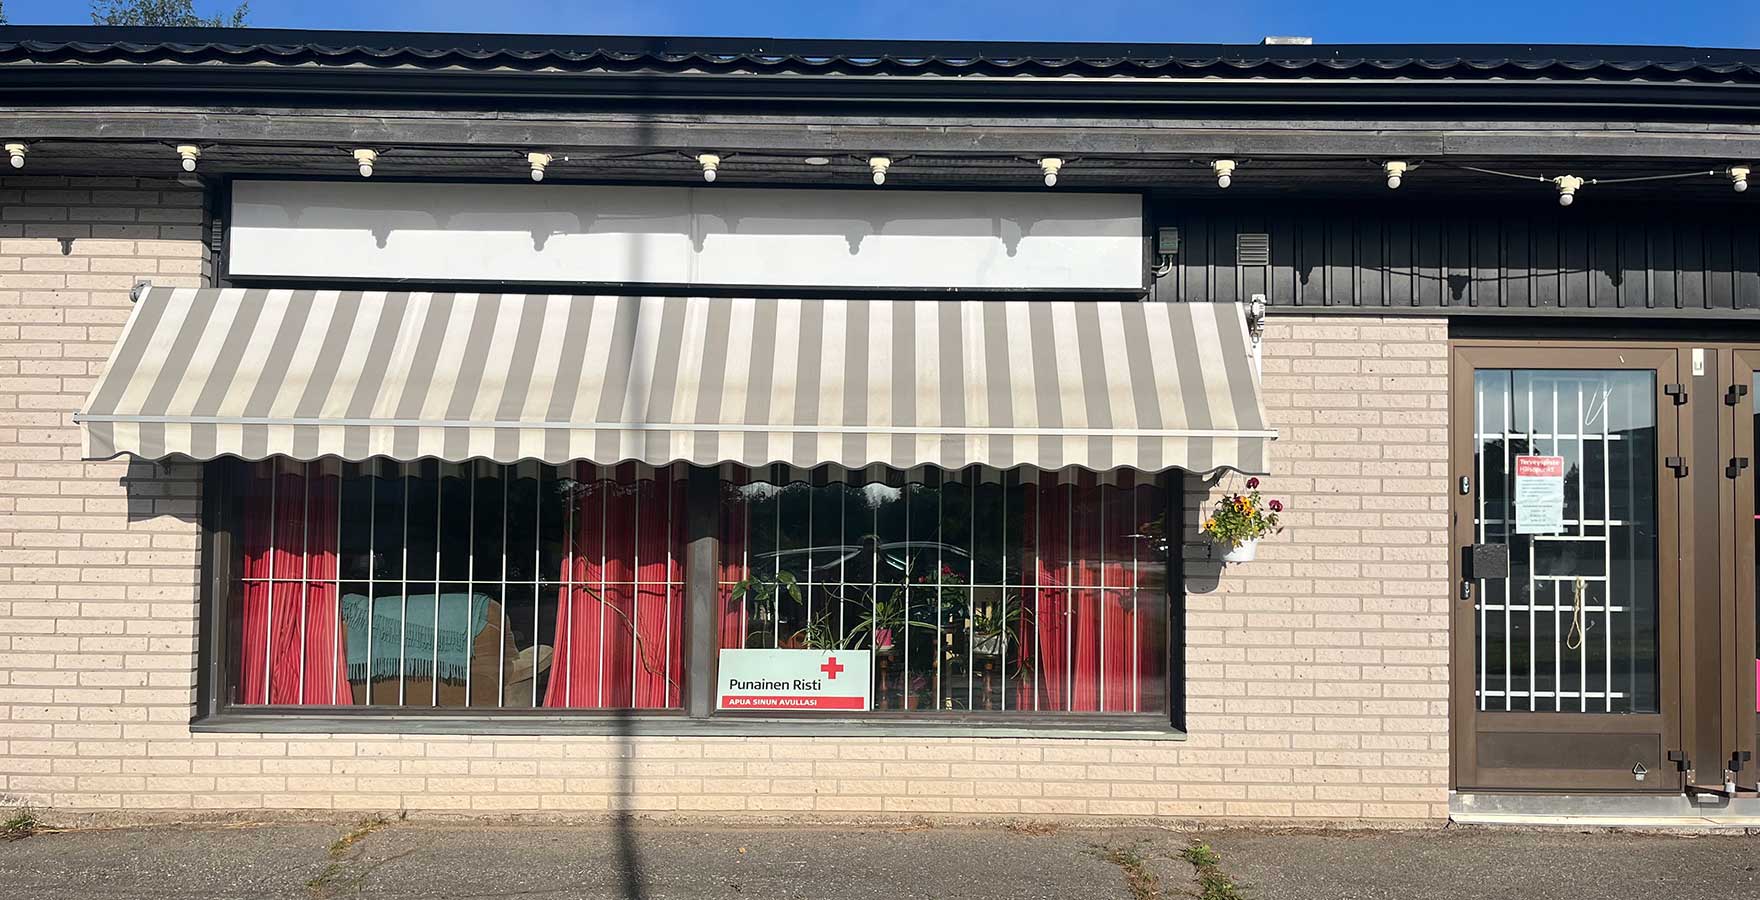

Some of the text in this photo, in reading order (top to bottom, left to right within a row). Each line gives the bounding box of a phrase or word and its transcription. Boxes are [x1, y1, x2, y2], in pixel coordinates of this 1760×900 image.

[729, 678, 822, 691] Punainen Risti
[752, 698, 778, 706] SINUN
